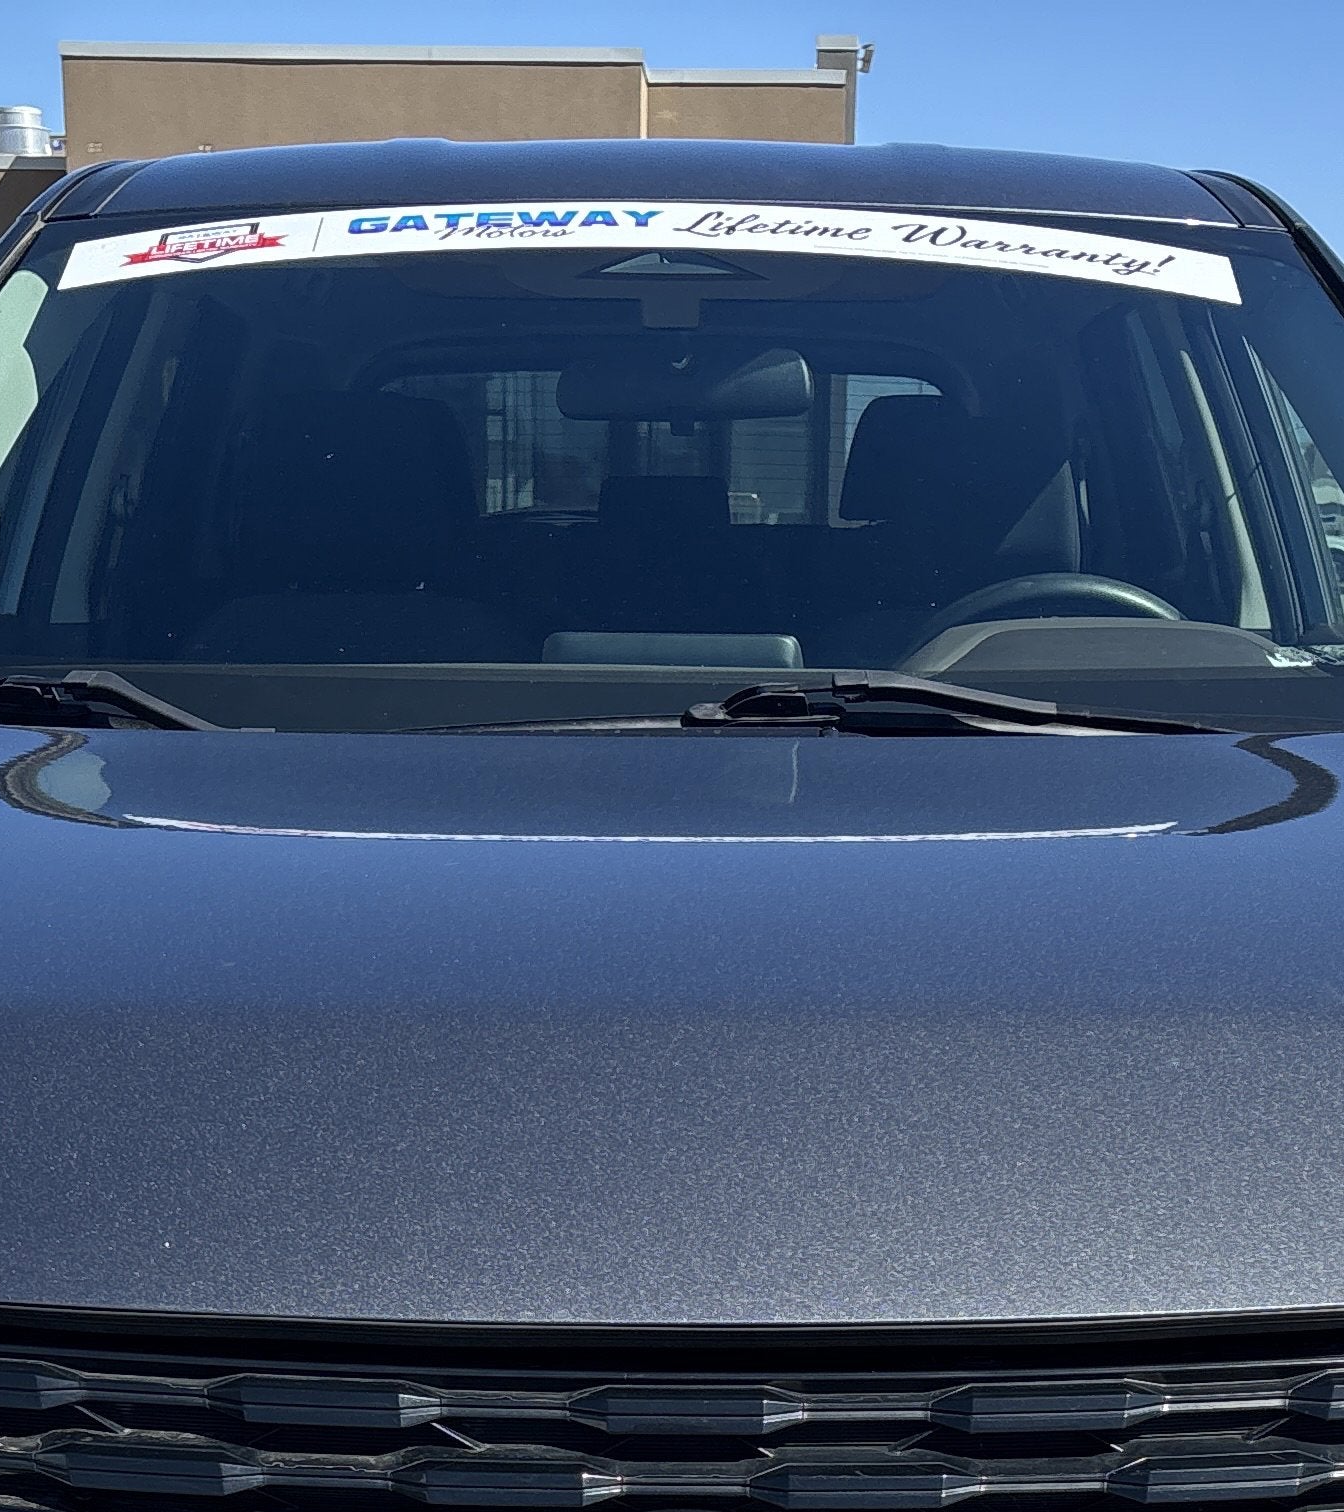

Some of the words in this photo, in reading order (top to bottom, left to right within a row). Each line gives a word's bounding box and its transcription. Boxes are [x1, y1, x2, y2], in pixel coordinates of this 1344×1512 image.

[347, 210, 664, 234] GATEWAY
[434, 223, 575, 241] Motors
[149, 234, 259, 256] LIFETIME
[673, 210, 873, 240] Lifetime
[892, 223, 1177, 276] Warranty!
